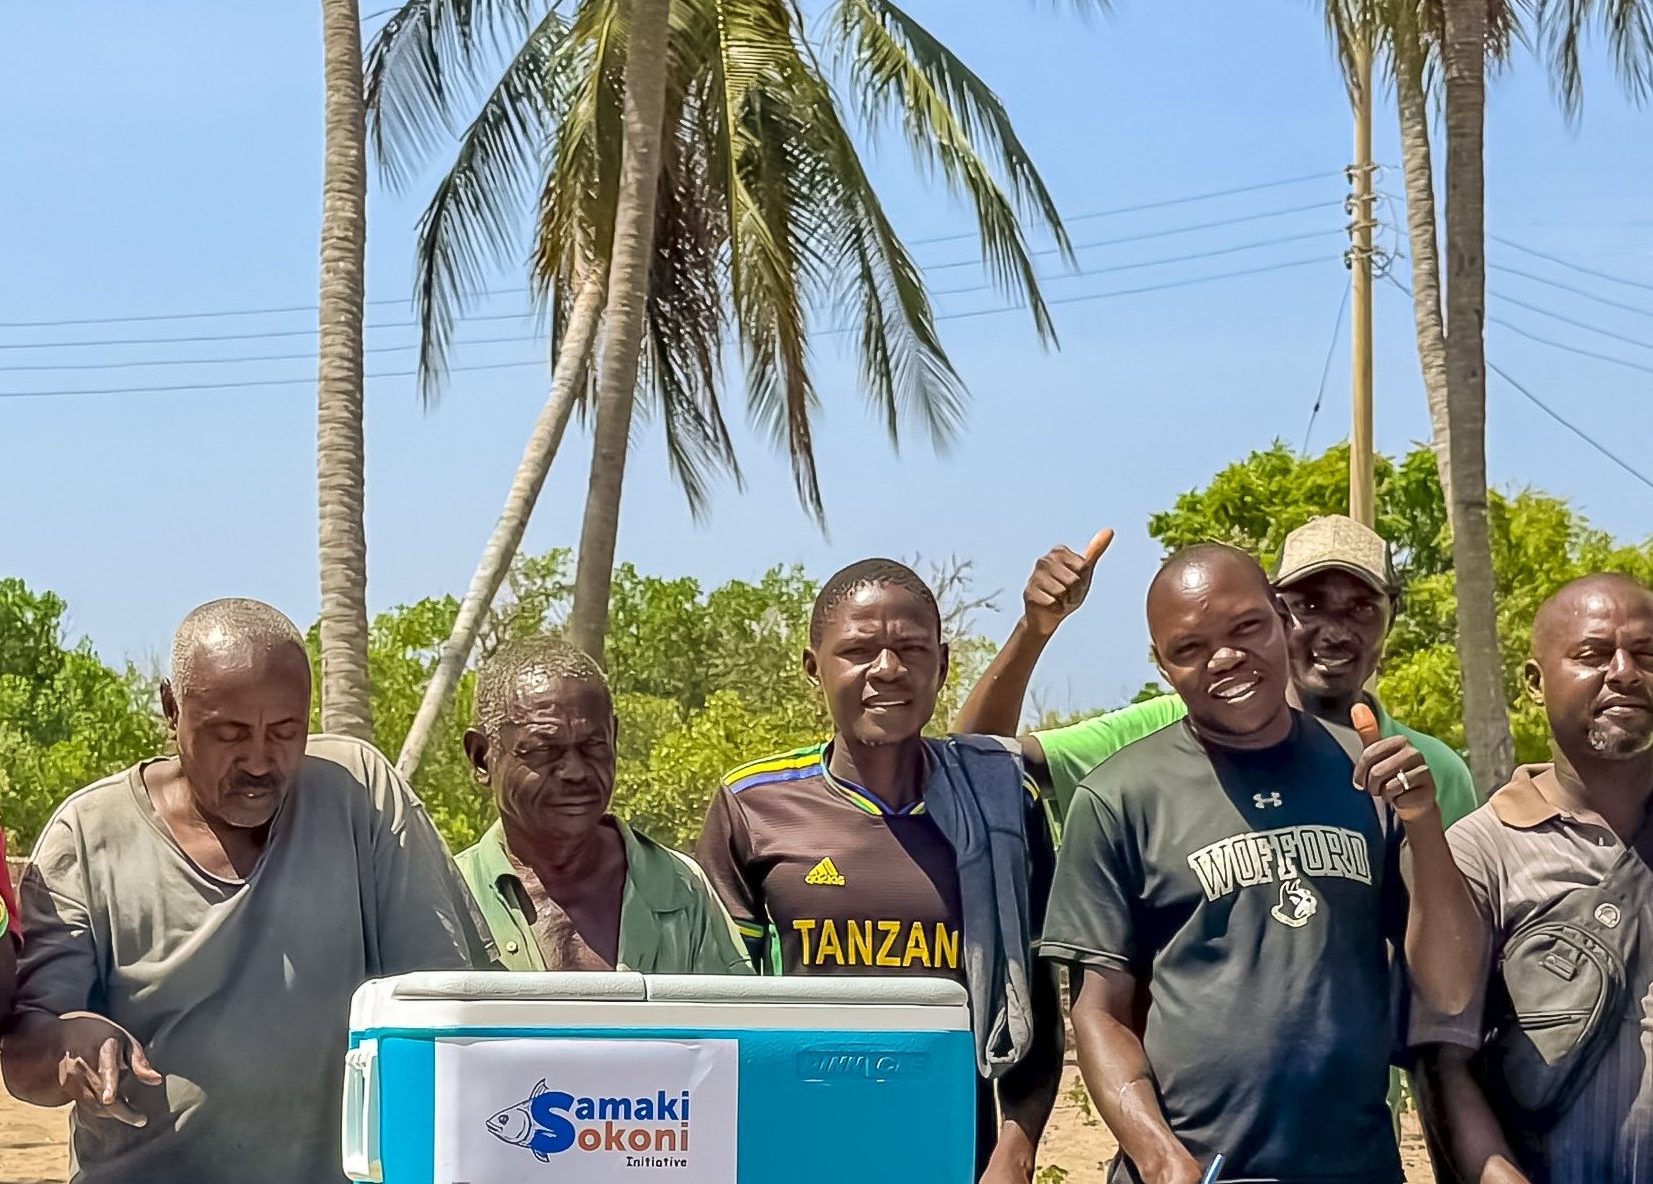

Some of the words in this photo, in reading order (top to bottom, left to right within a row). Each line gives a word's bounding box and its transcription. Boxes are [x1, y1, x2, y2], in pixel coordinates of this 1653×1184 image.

[1187, 825, 1372, 901] WOFFORD
[793, 919, 959, 969] TANZAN
[626, 1156, 687, 1167] Initiative
